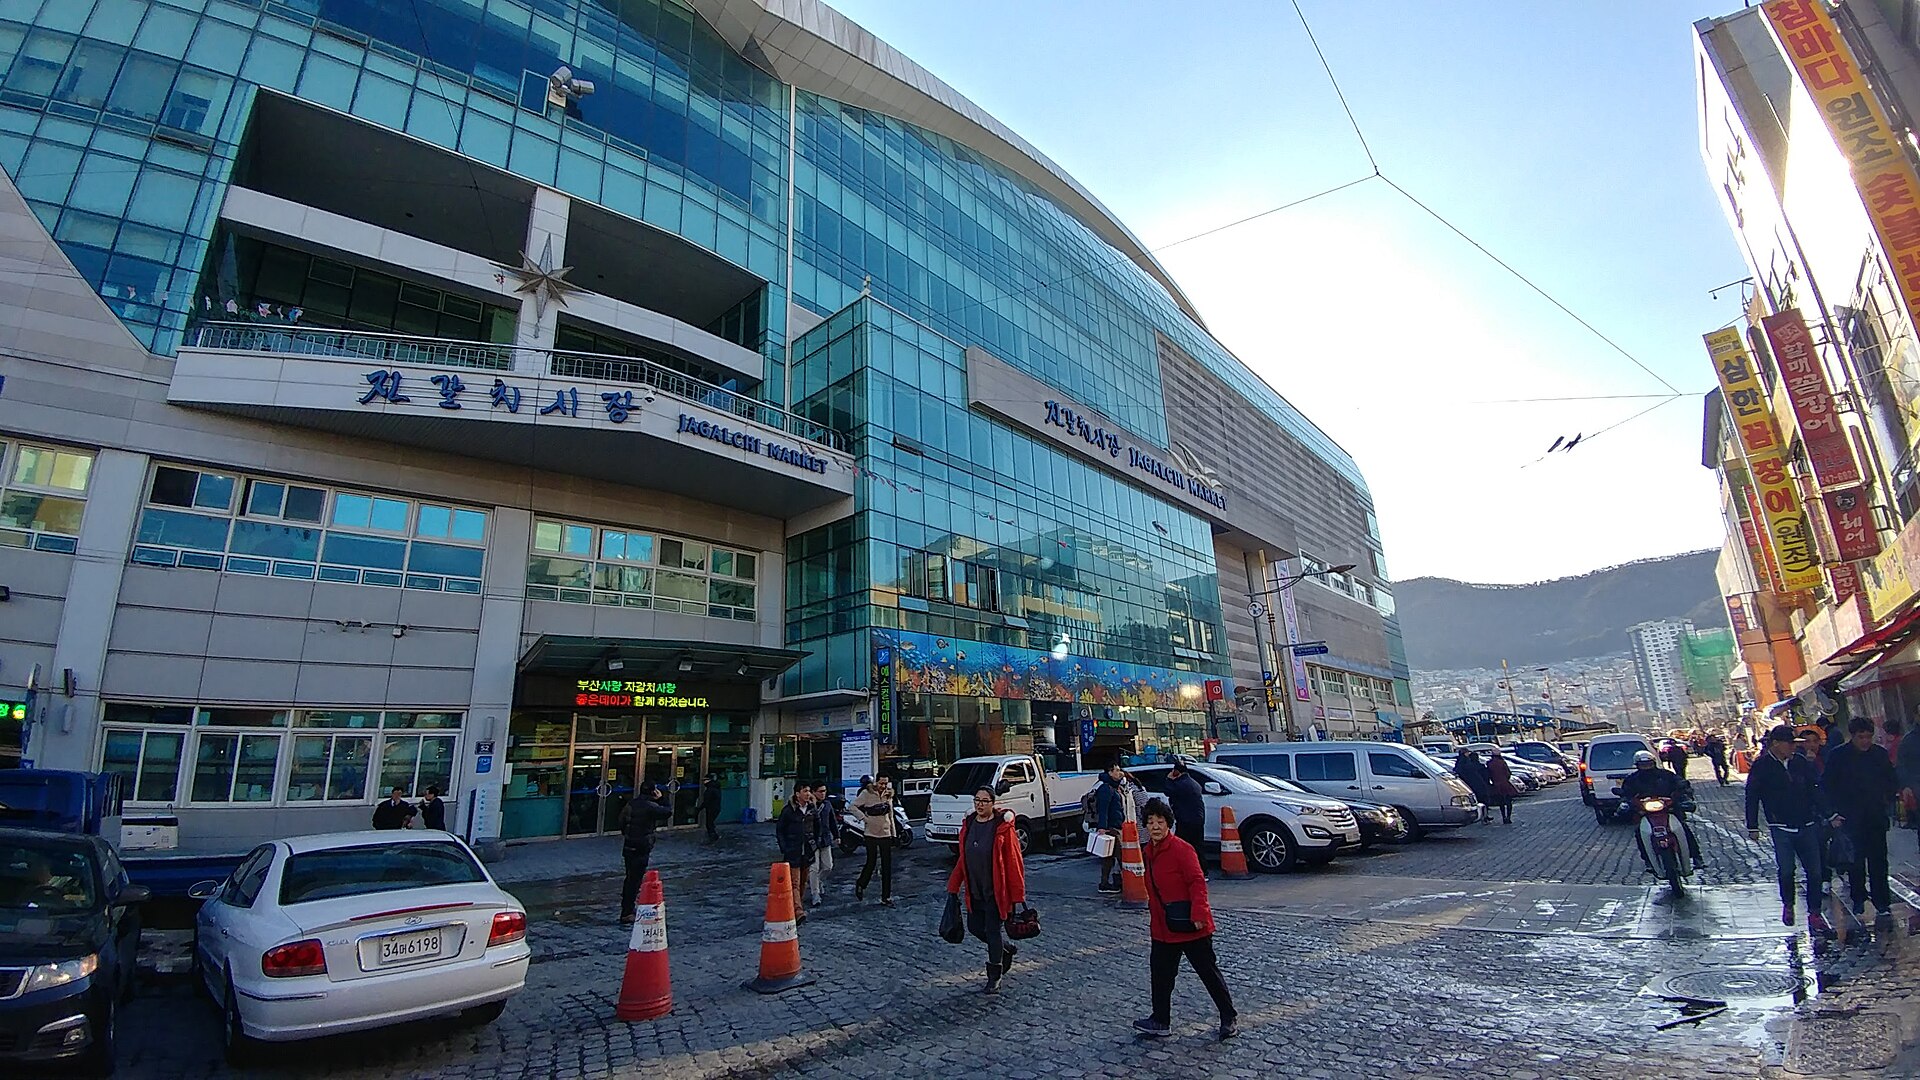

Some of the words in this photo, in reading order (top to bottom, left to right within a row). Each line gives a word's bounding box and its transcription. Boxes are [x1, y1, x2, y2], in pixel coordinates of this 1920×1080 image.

[356, 369, 640, 424] 자갈치시장
[677, 413, 762, 454] JAGALCHI
[767, 442, 829, 475] MARKET
[1044, 399, 1122, 458] 자갈치시장
[1129, 446, 1185, 490] JAGALCHI
[1187, 478, 1228, 511] MARKET
[575, 694, 631, 707] 좋은데이가
[633, 695, 655, 707] 함께
[657, 696, 710, 708] 하겠습니다.
[577, 680, 622, 693] 부산사랑
[623, 681, 677, 694] 자갈치사랑
[880, 665, 891, 735] 에스컬레이터
